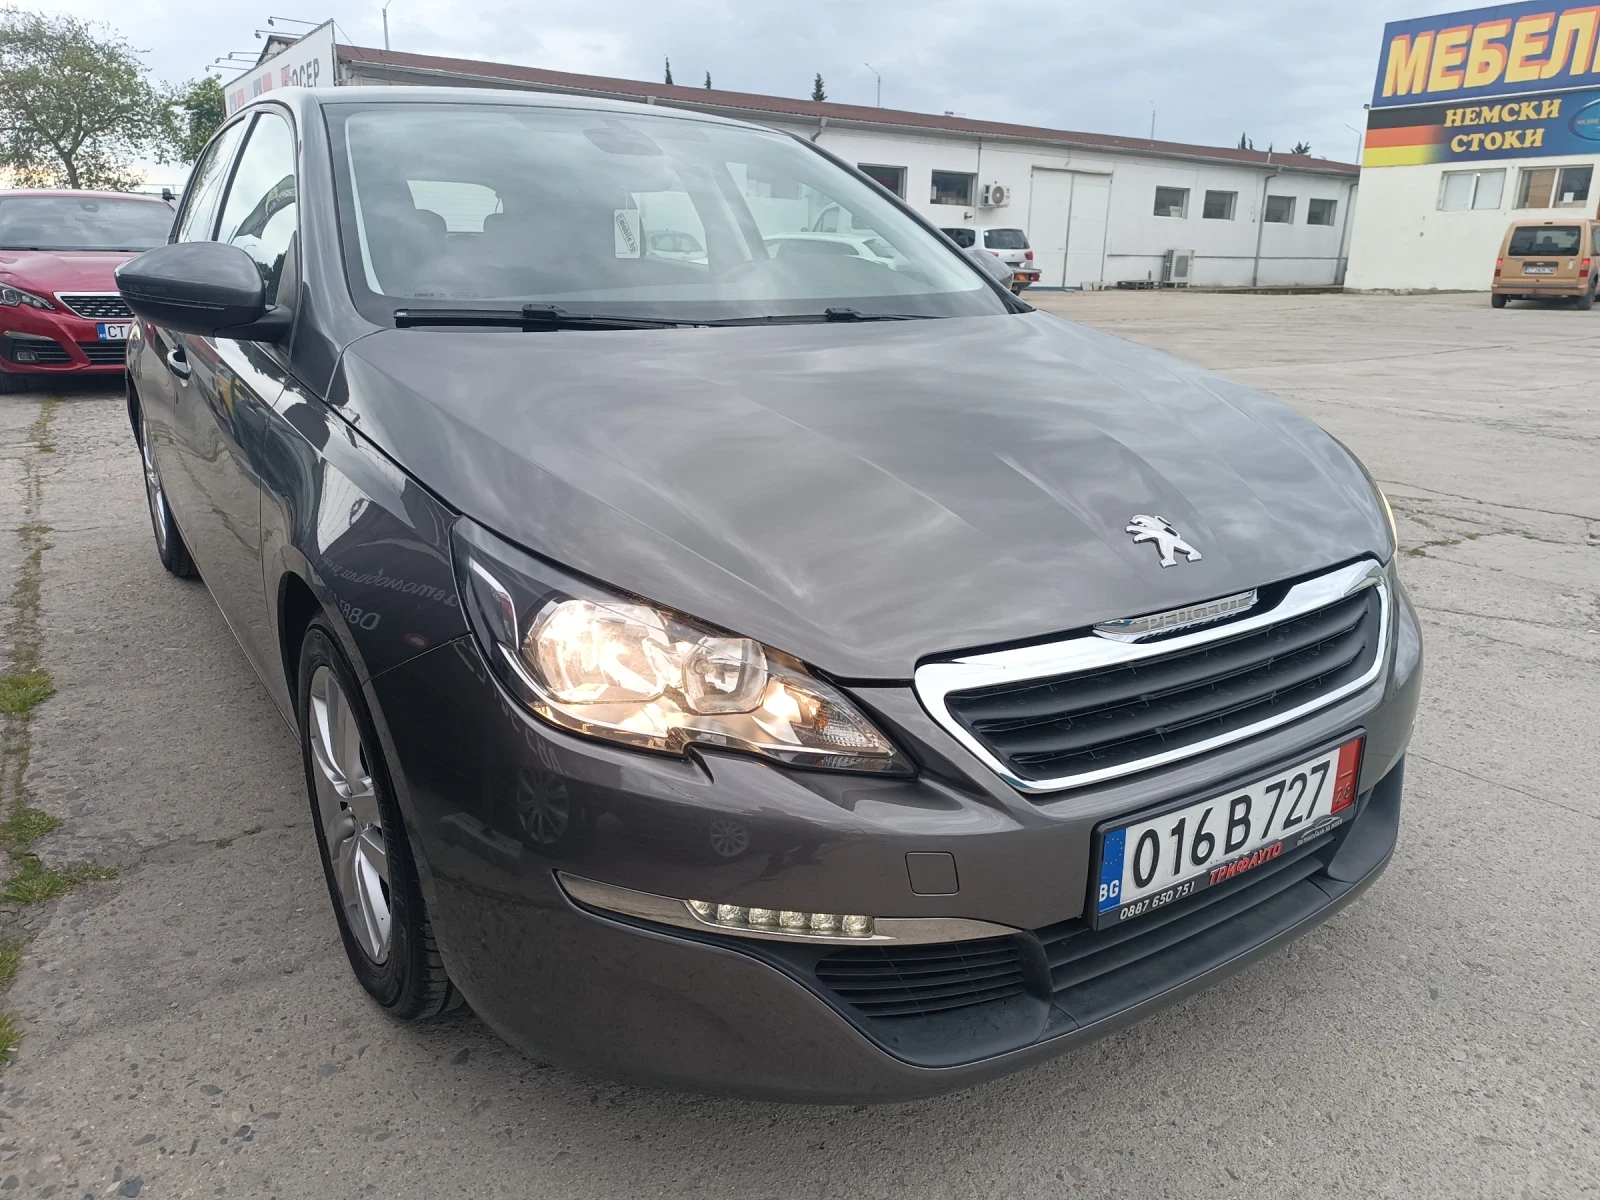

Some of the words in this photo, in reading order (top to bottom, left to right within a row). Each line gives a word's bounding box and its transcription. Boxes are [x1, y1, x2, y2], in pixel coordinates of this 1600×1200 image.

[1381, 5, 1600, 98] МЕБЕЛ
[1443, 98, 1563, 128] НЕМСКИ
[1450, 128, 1546, 153] СТОКИ
[618, 218, 637, 252] mobile.bg
[107, 325, 125, 338] CT
[1209, 841, 1283, 886] ТРИФАУТО
[1099, 879, 1120, 903] BG
[1119, 899, 1150, 920] 0887
[1151, 890, 1174, 908] 650
[1175, 881, 1195, 899] 751
